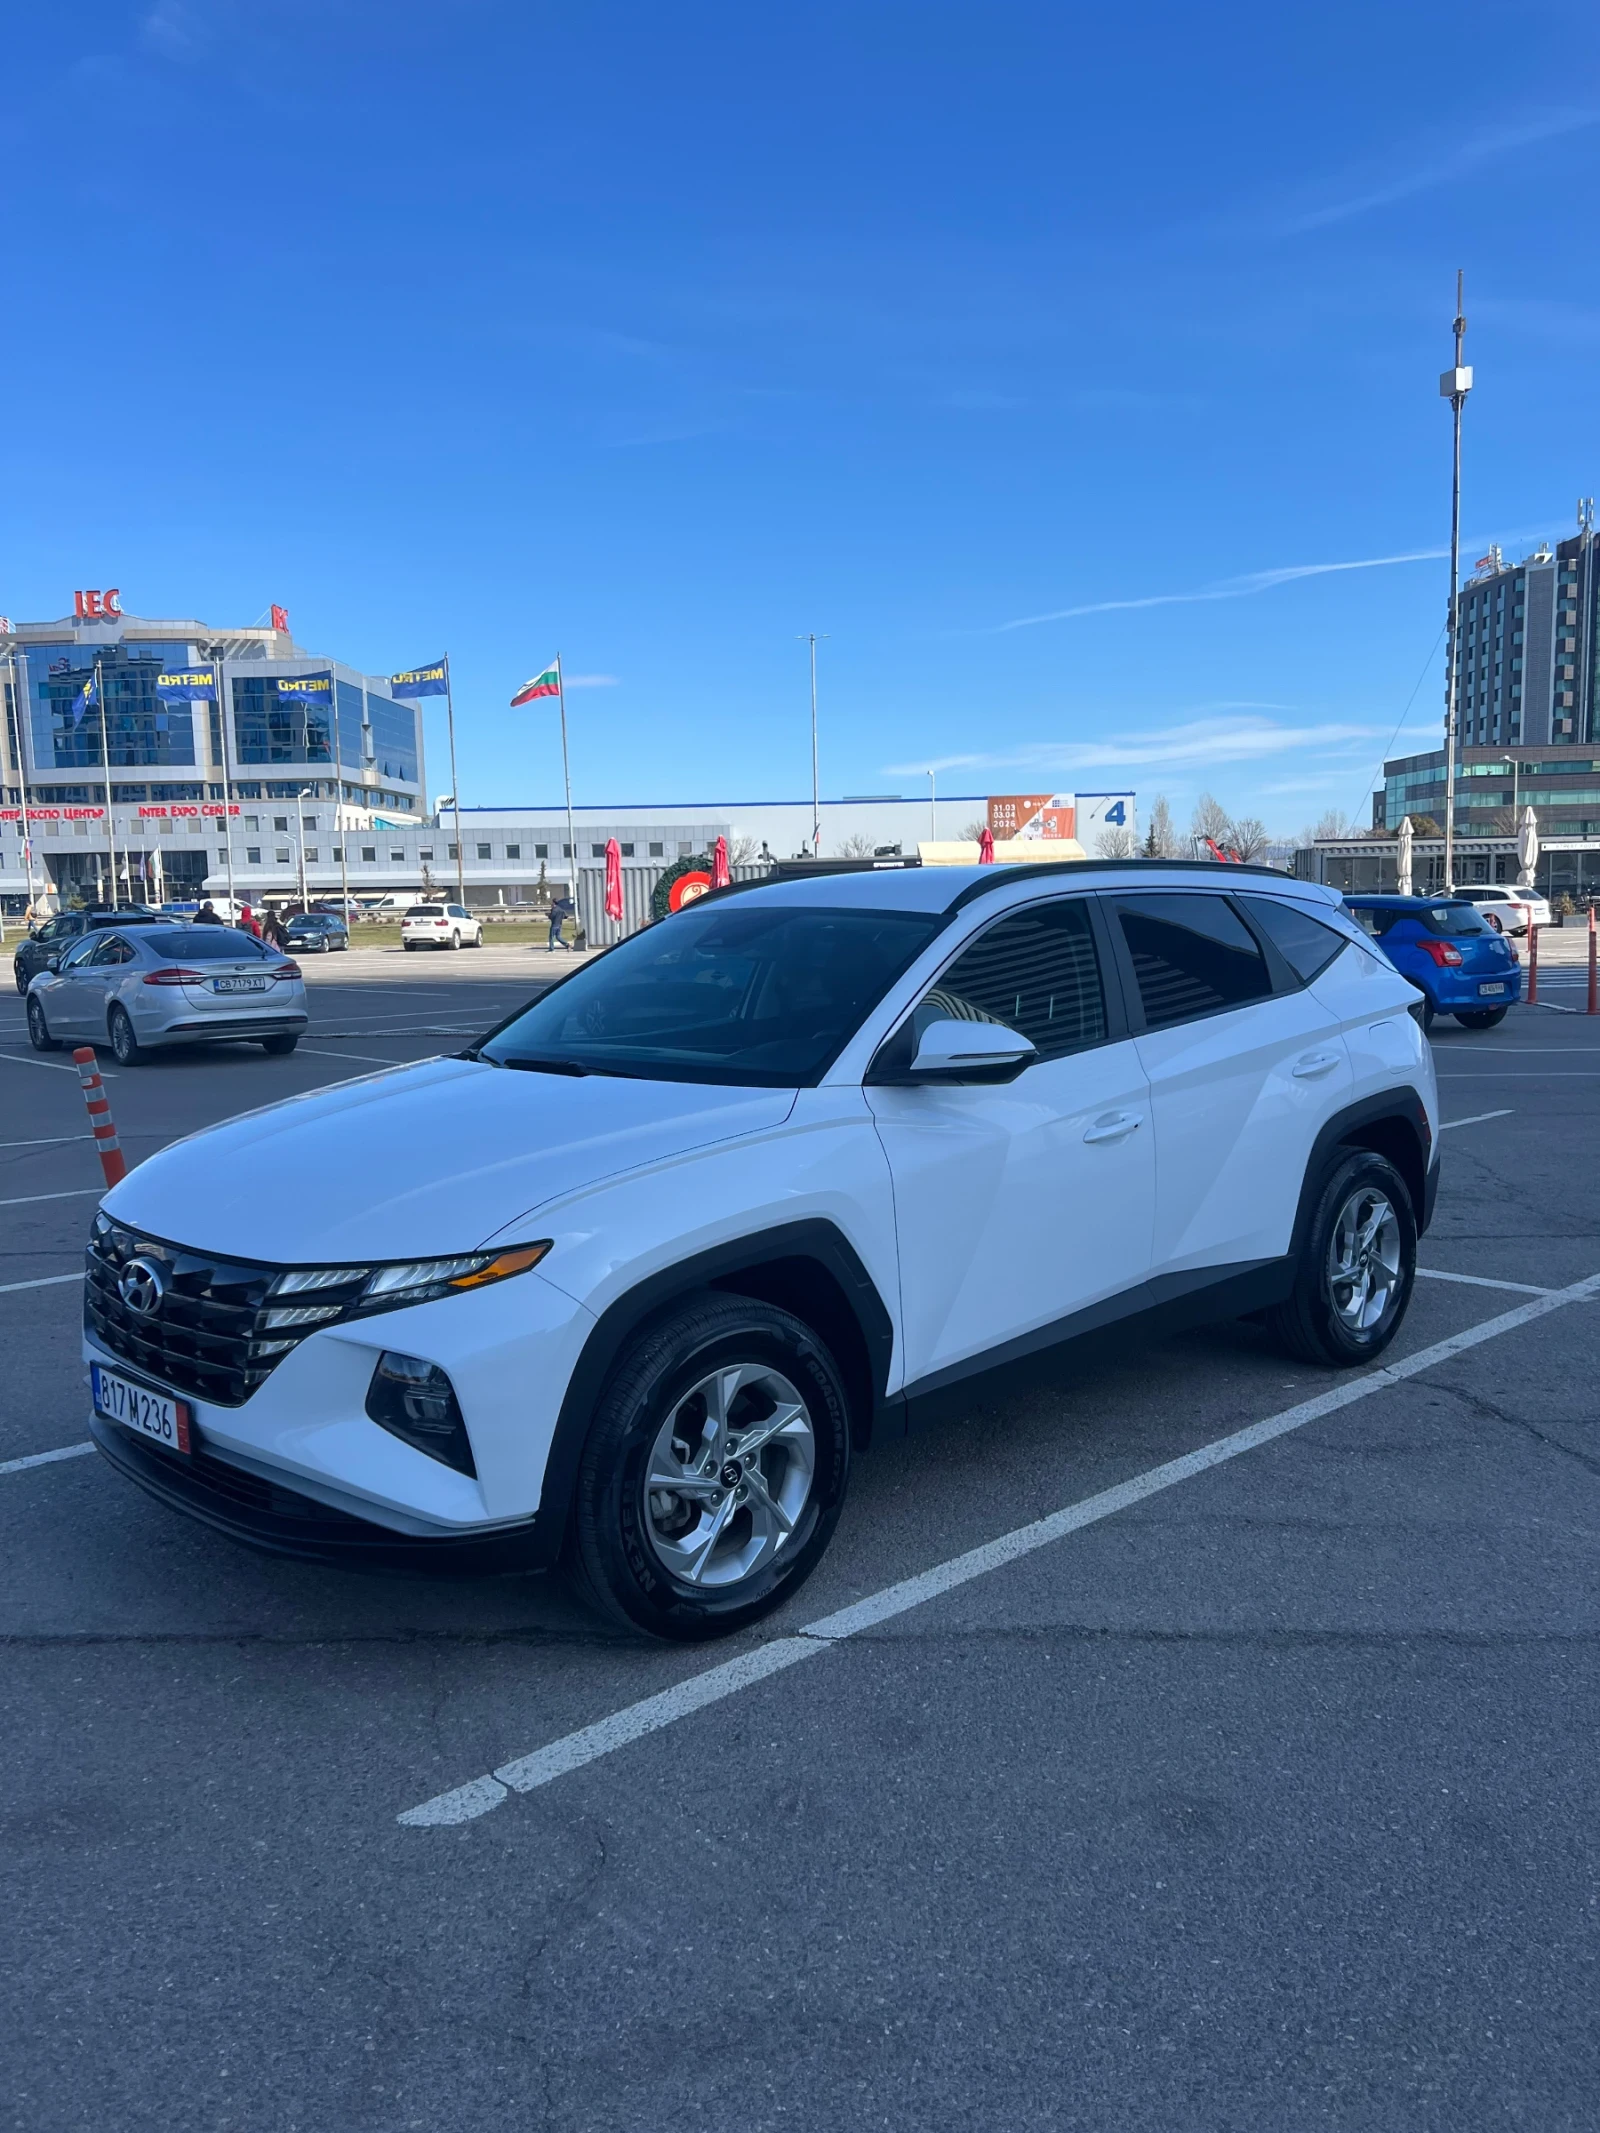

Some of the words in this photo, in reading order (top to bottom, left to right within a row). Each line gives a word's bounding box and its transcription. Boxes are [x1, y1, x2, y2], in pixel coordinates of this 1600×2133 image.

[74, 588, 121, 618] IEC
[201, 804, 241, 816] CENER
[993, 804, 1016, 812] 31.03
[1104, 800, 1126, 826] 4
[993, 811, 1016, 819] 03.04
[993, 820, 1016, 828] 2026
[622, 1481, 656, 1592] NEXEN
